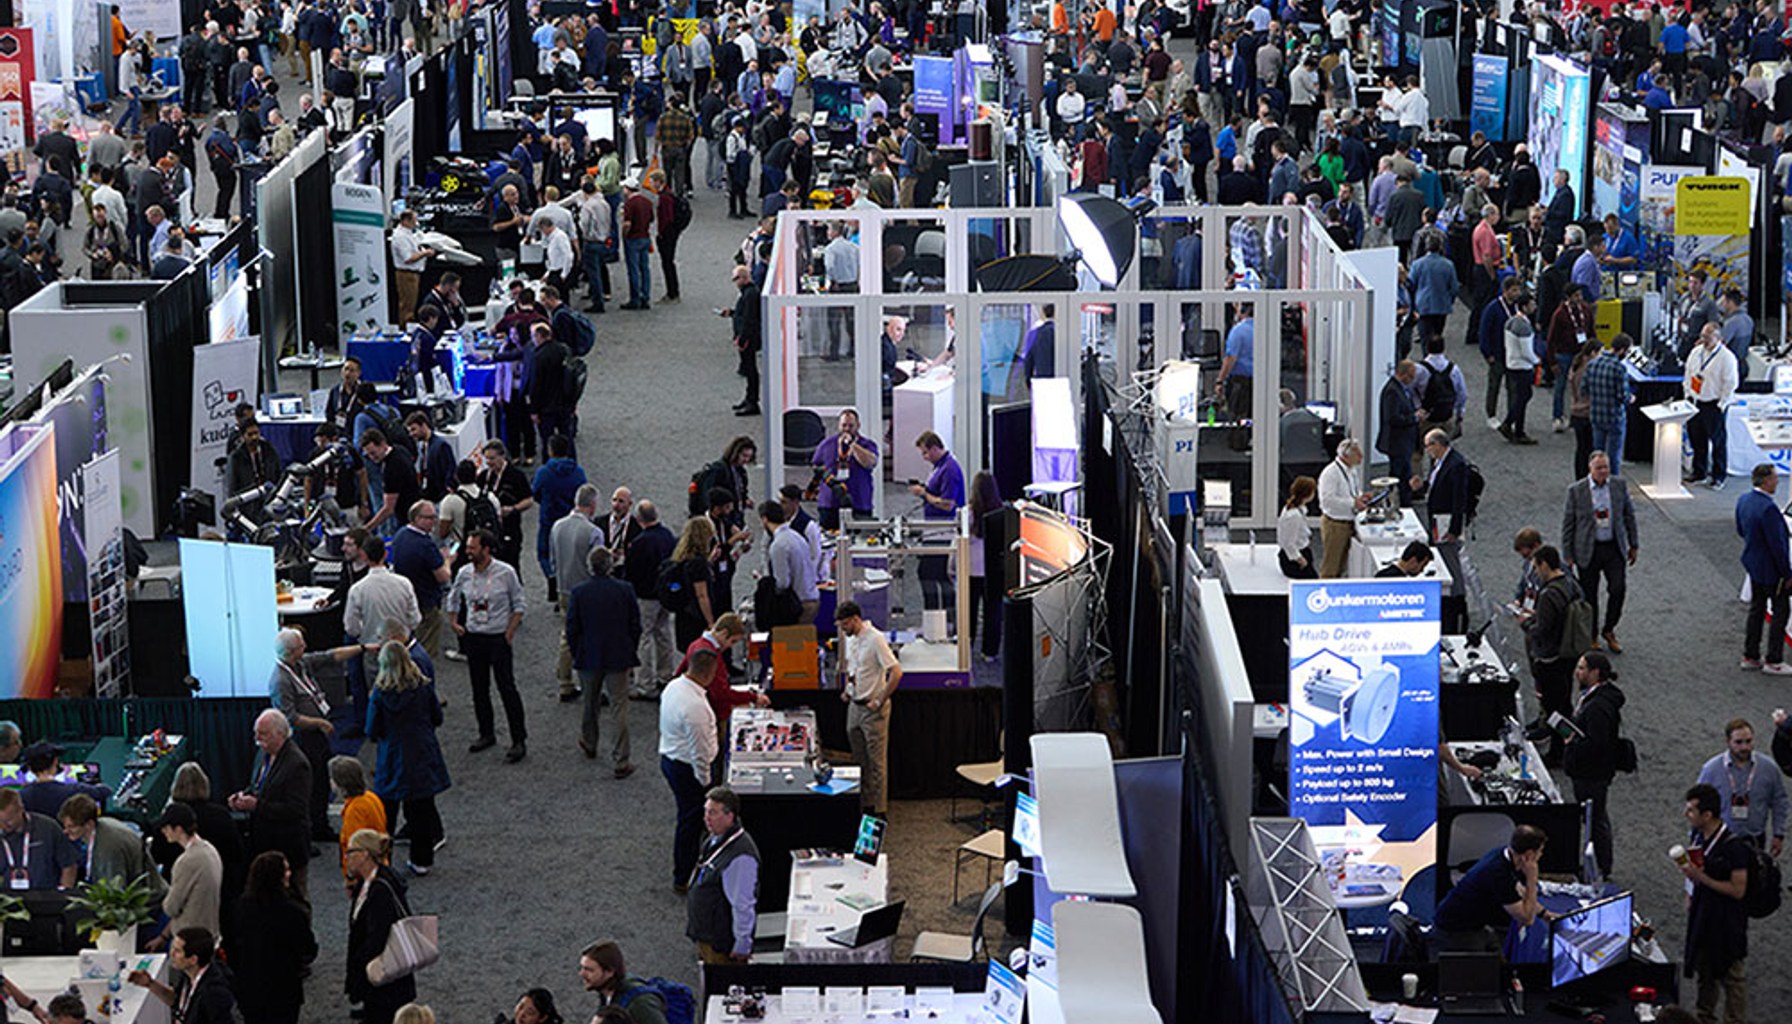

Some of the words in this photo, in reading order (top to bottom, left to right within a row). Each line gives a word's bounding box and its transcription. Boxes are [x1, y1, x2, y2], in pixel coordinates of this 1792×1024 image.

[1178, 392, 1194, 416] PI
[200, 423, 231, 444] kud
[1175, 440, 1193, 452] PI
[1298, 628, 1329, 641] Hub
[1333, 627, 1372, 641] Drive
[1326, 749, 1354, 759] Power
[1356, 749, 1376, 758] with
[1377, 748, 1402, 758] Small
[1403, 748, 1435, 758] Design
[1302, 764, 1332, 775] Speed
[1333, 766, 1345, 775] up
[1346, 764, 1356, 773] to
[1302, 779, 1339, 790] Payload
[1339, 780, 1351, 790] up
[1352, 779, 1363, 788] to
[1382, 778, 1395, 789] kg
[1302, 793, 1339, 804] Optional
[1341, 792, 1368, 804] Safety
[1369, 792, 1407, 802] Encoder
